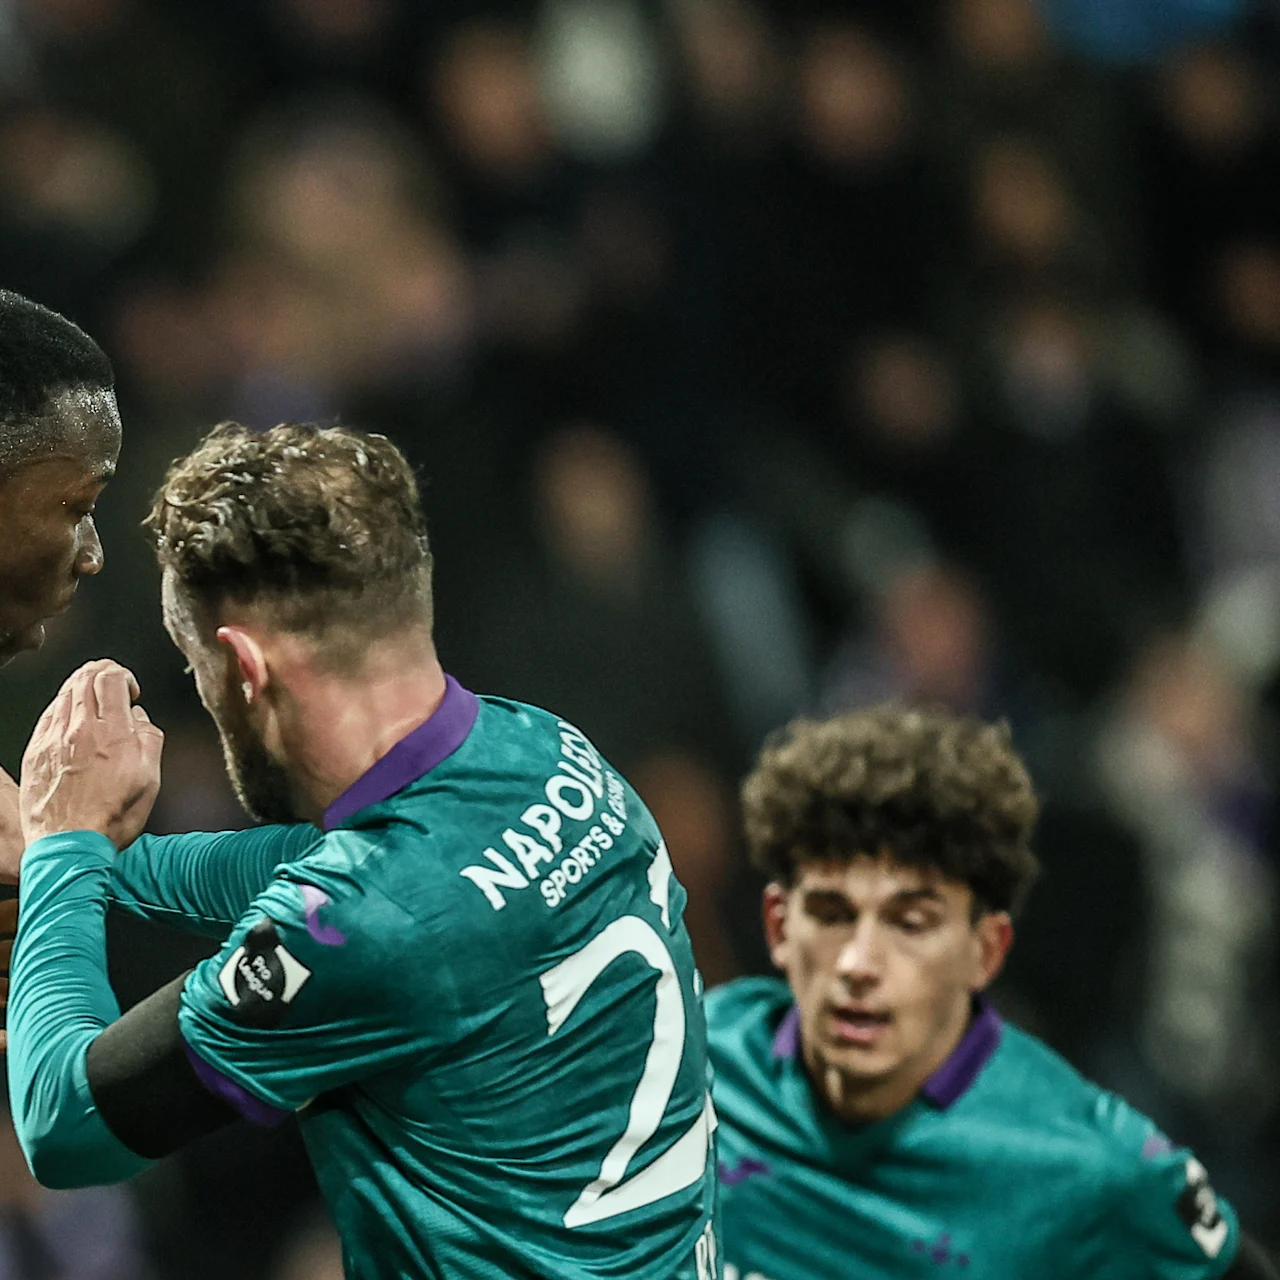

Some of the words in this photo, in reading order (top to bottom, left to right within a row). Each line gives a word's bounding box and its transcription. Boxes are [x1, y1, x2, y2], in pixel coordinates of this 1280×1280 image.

[540, 825, 614, 908] SPORTS
[600, 811, 626, 837] &
[539, 838, 718, 1230] 2
